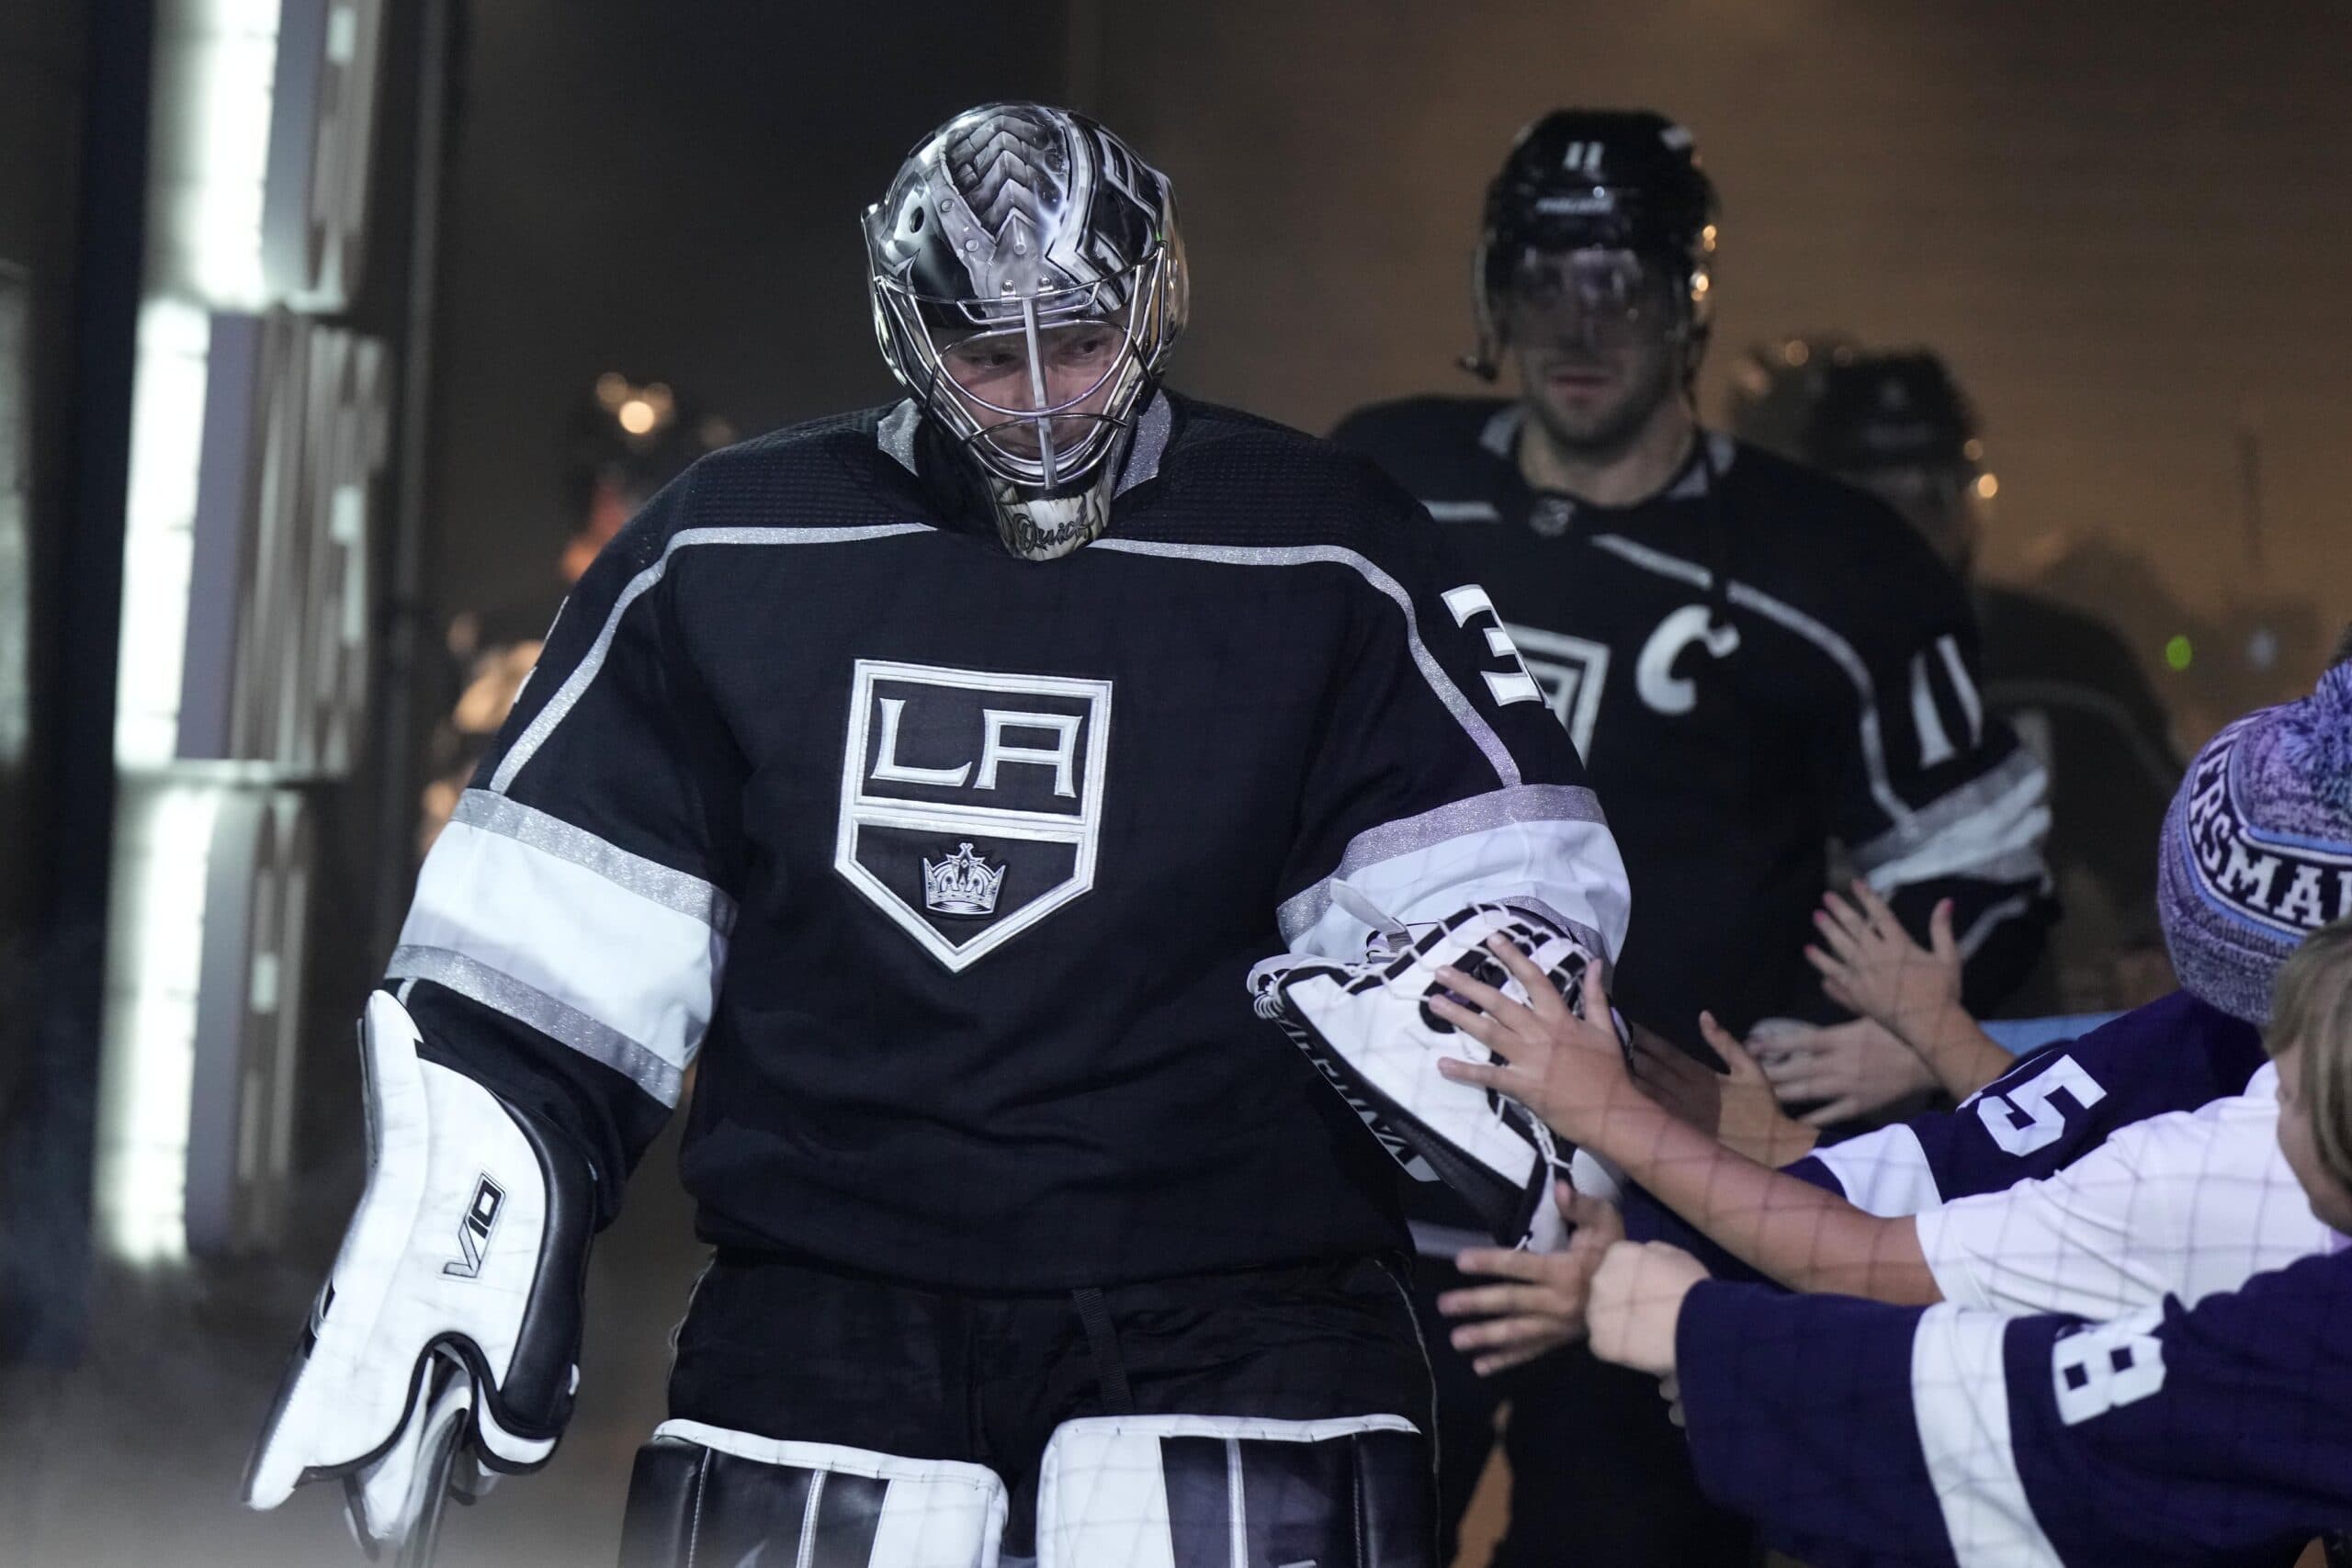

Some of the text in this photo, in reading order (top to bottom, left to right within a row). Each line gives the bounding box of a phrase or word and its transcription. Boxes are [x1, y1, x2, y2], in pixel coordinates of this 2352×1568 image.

[1441, 584, 1551, 709] 3
[1636, 604, 1741, 716] C
[870, 697, 1083, 798] LA
[1955, 1047, 2107, 1157] 5
